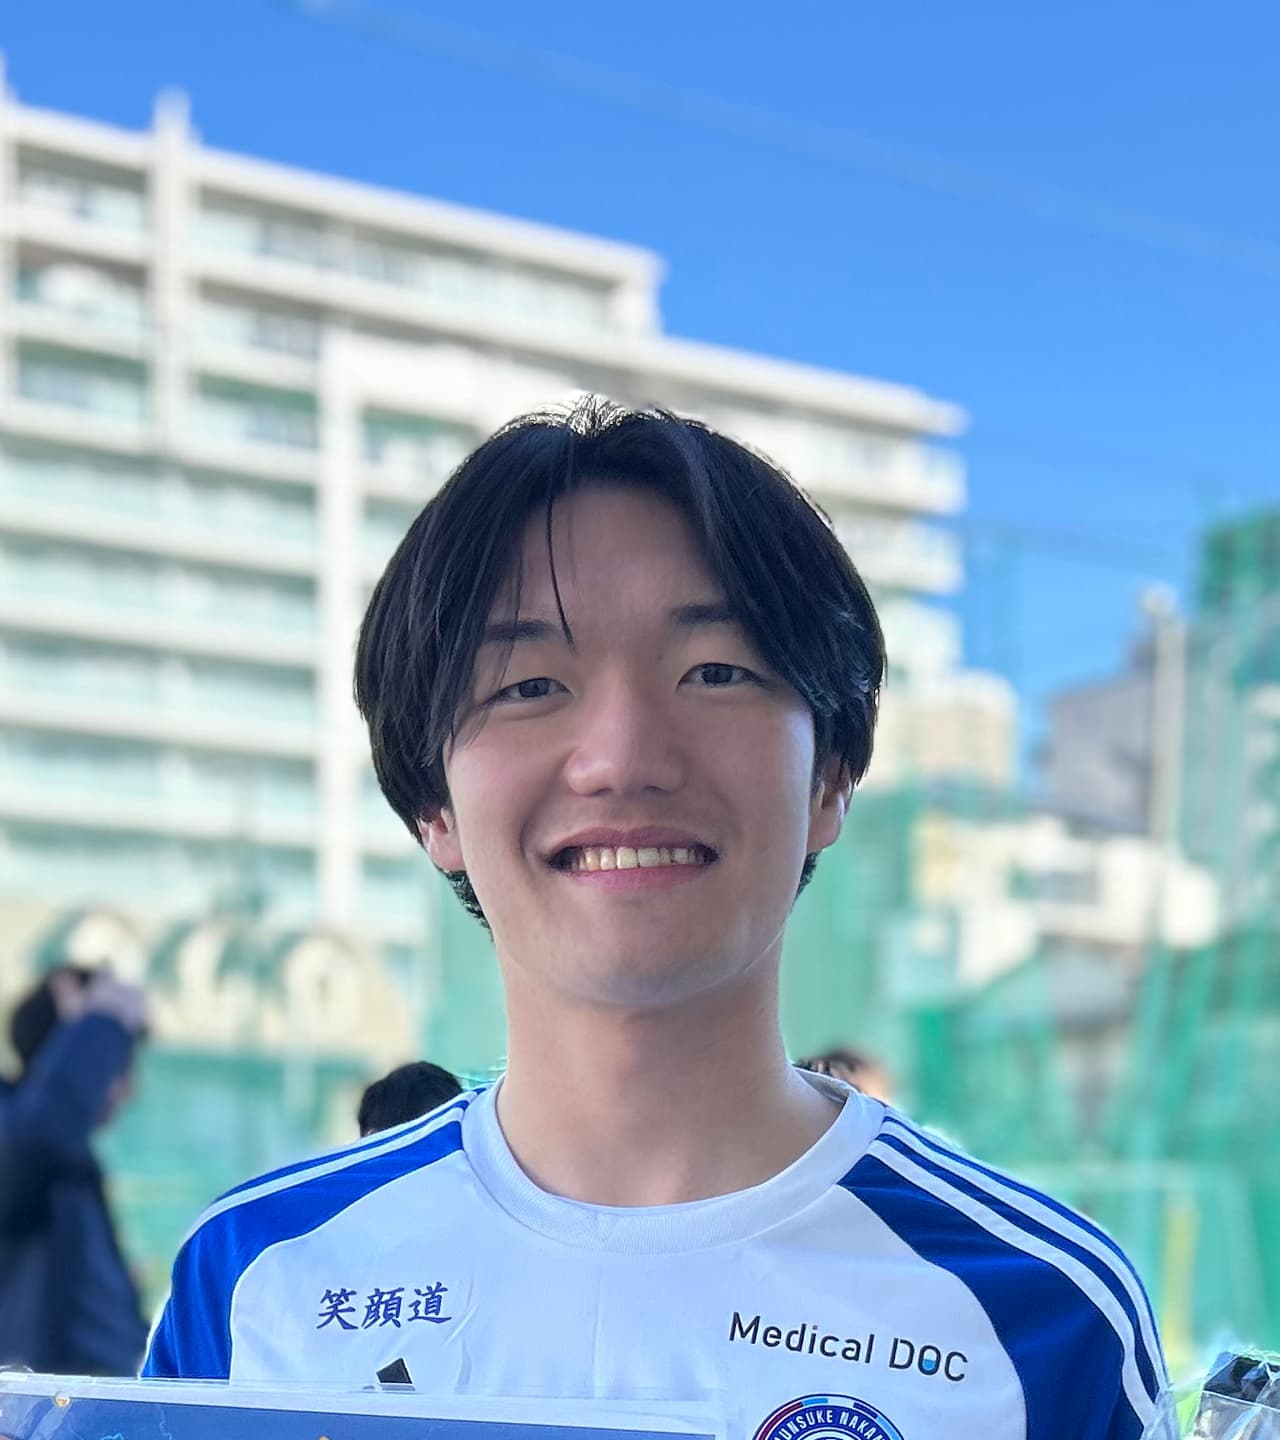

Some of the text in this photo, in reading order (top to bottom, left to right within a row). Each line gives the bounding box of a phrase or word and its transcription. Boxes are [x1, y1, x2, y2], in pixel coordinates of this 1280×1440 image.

[316, 1281, 452, 1330] 笑顔道
[729, 1311, 969, 1382] Medical DOC
